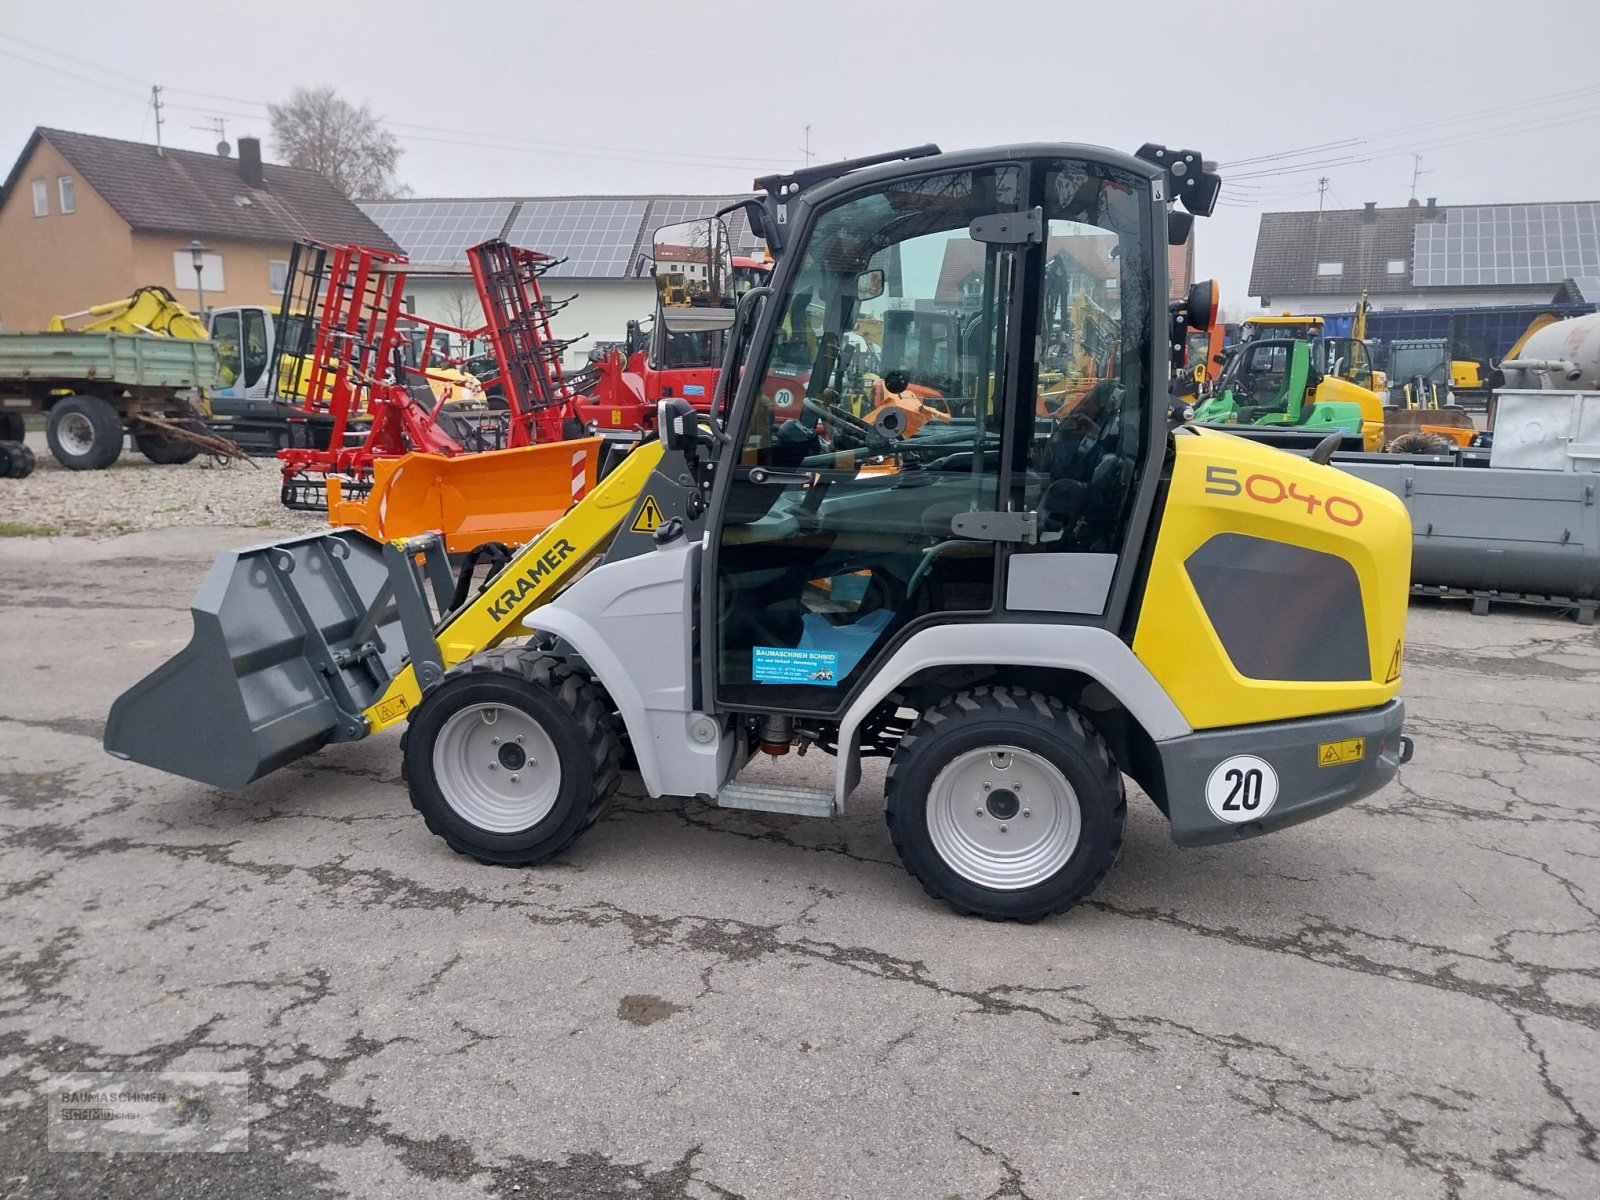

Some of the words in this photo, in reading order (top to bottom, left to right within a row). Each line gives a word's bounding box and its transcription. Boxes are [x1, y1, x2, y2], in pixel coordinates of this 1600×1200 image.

[777, 392, 790, 404] 20
[1205, 465, 1364, 527] 5040
[486, 538, 577, 623] KRAMER
[755, 649, 808, 659] BAUMASCHINEN
[1222, 768, 1263, 811] 20
